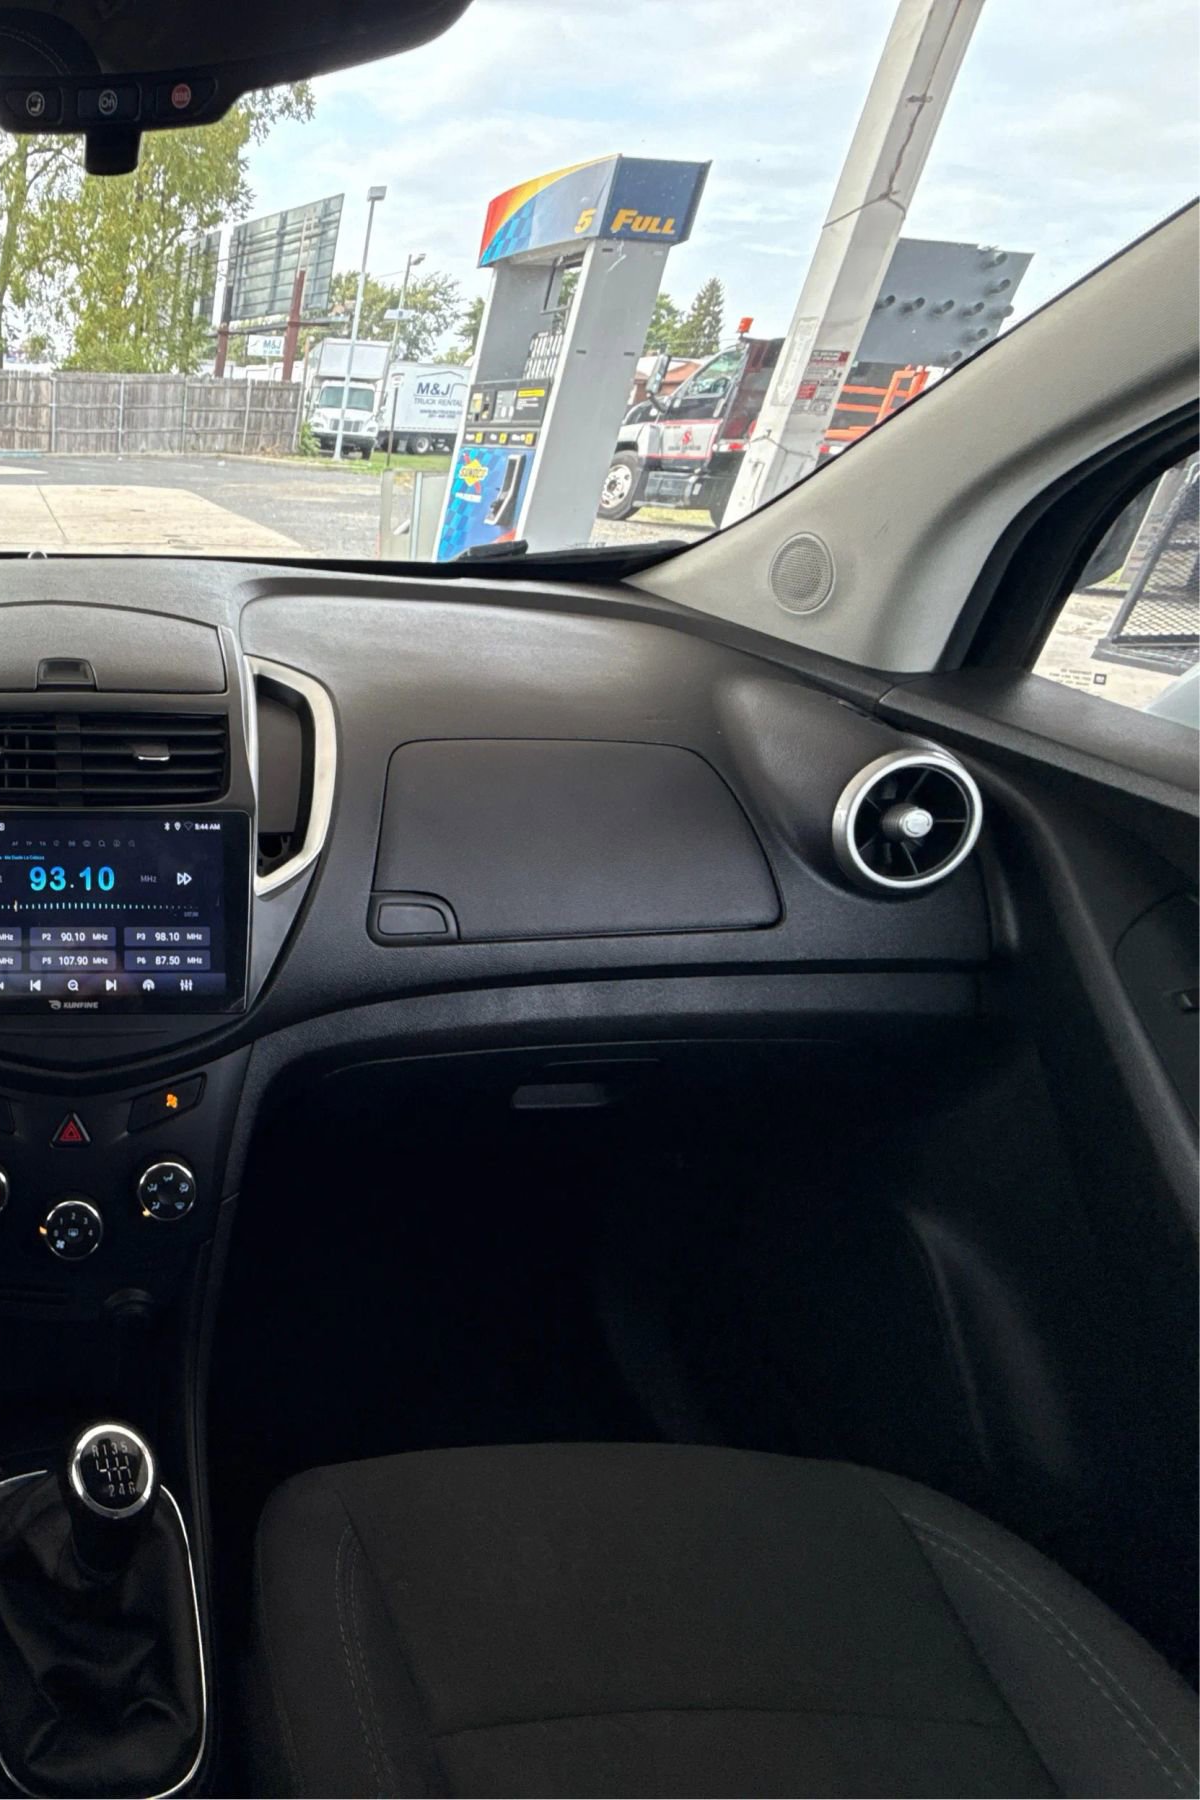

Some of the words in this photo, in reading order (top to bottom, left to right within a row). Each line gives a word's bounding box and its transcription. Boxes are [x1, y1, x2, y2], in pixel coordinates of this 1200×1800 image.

[575, 208, 597, 234] 5
[416, 382, 451, 396] M&J
[414, 397, 437, 406] TRUCK
[30, 866, 115, 891] 93.10
[140, 875, 157, 883] MHz
[42, 933, 51, 941] P2
[60, 932, 86, 942] 90.10
[92, 933, 108, 941] MHz
[136, 933, 146, 941] P3
[155, 932, 180, 942] 98.10
[187, 933, 202, 941] MHz
[42, 957, 52, 965] P5
[59, 956, 89, 966] 107.90
[92, 957, 108, 965] MHz
[136, 957, 146, 965] P6
[155, 956, 180, 966] 87.50
[187, 957, 202, 965] MHz
[92, 1444, 99, 1457] R
[102, 1444, 107, 1455] 1
[111, 1442, 118, 1455] 3
[121, 1441, 128, 1453] 5
[108, 1484, 115, 1497] 2
[118, 1483, 126, 1495] 4
[127, 1481, 136, 1495] 6
